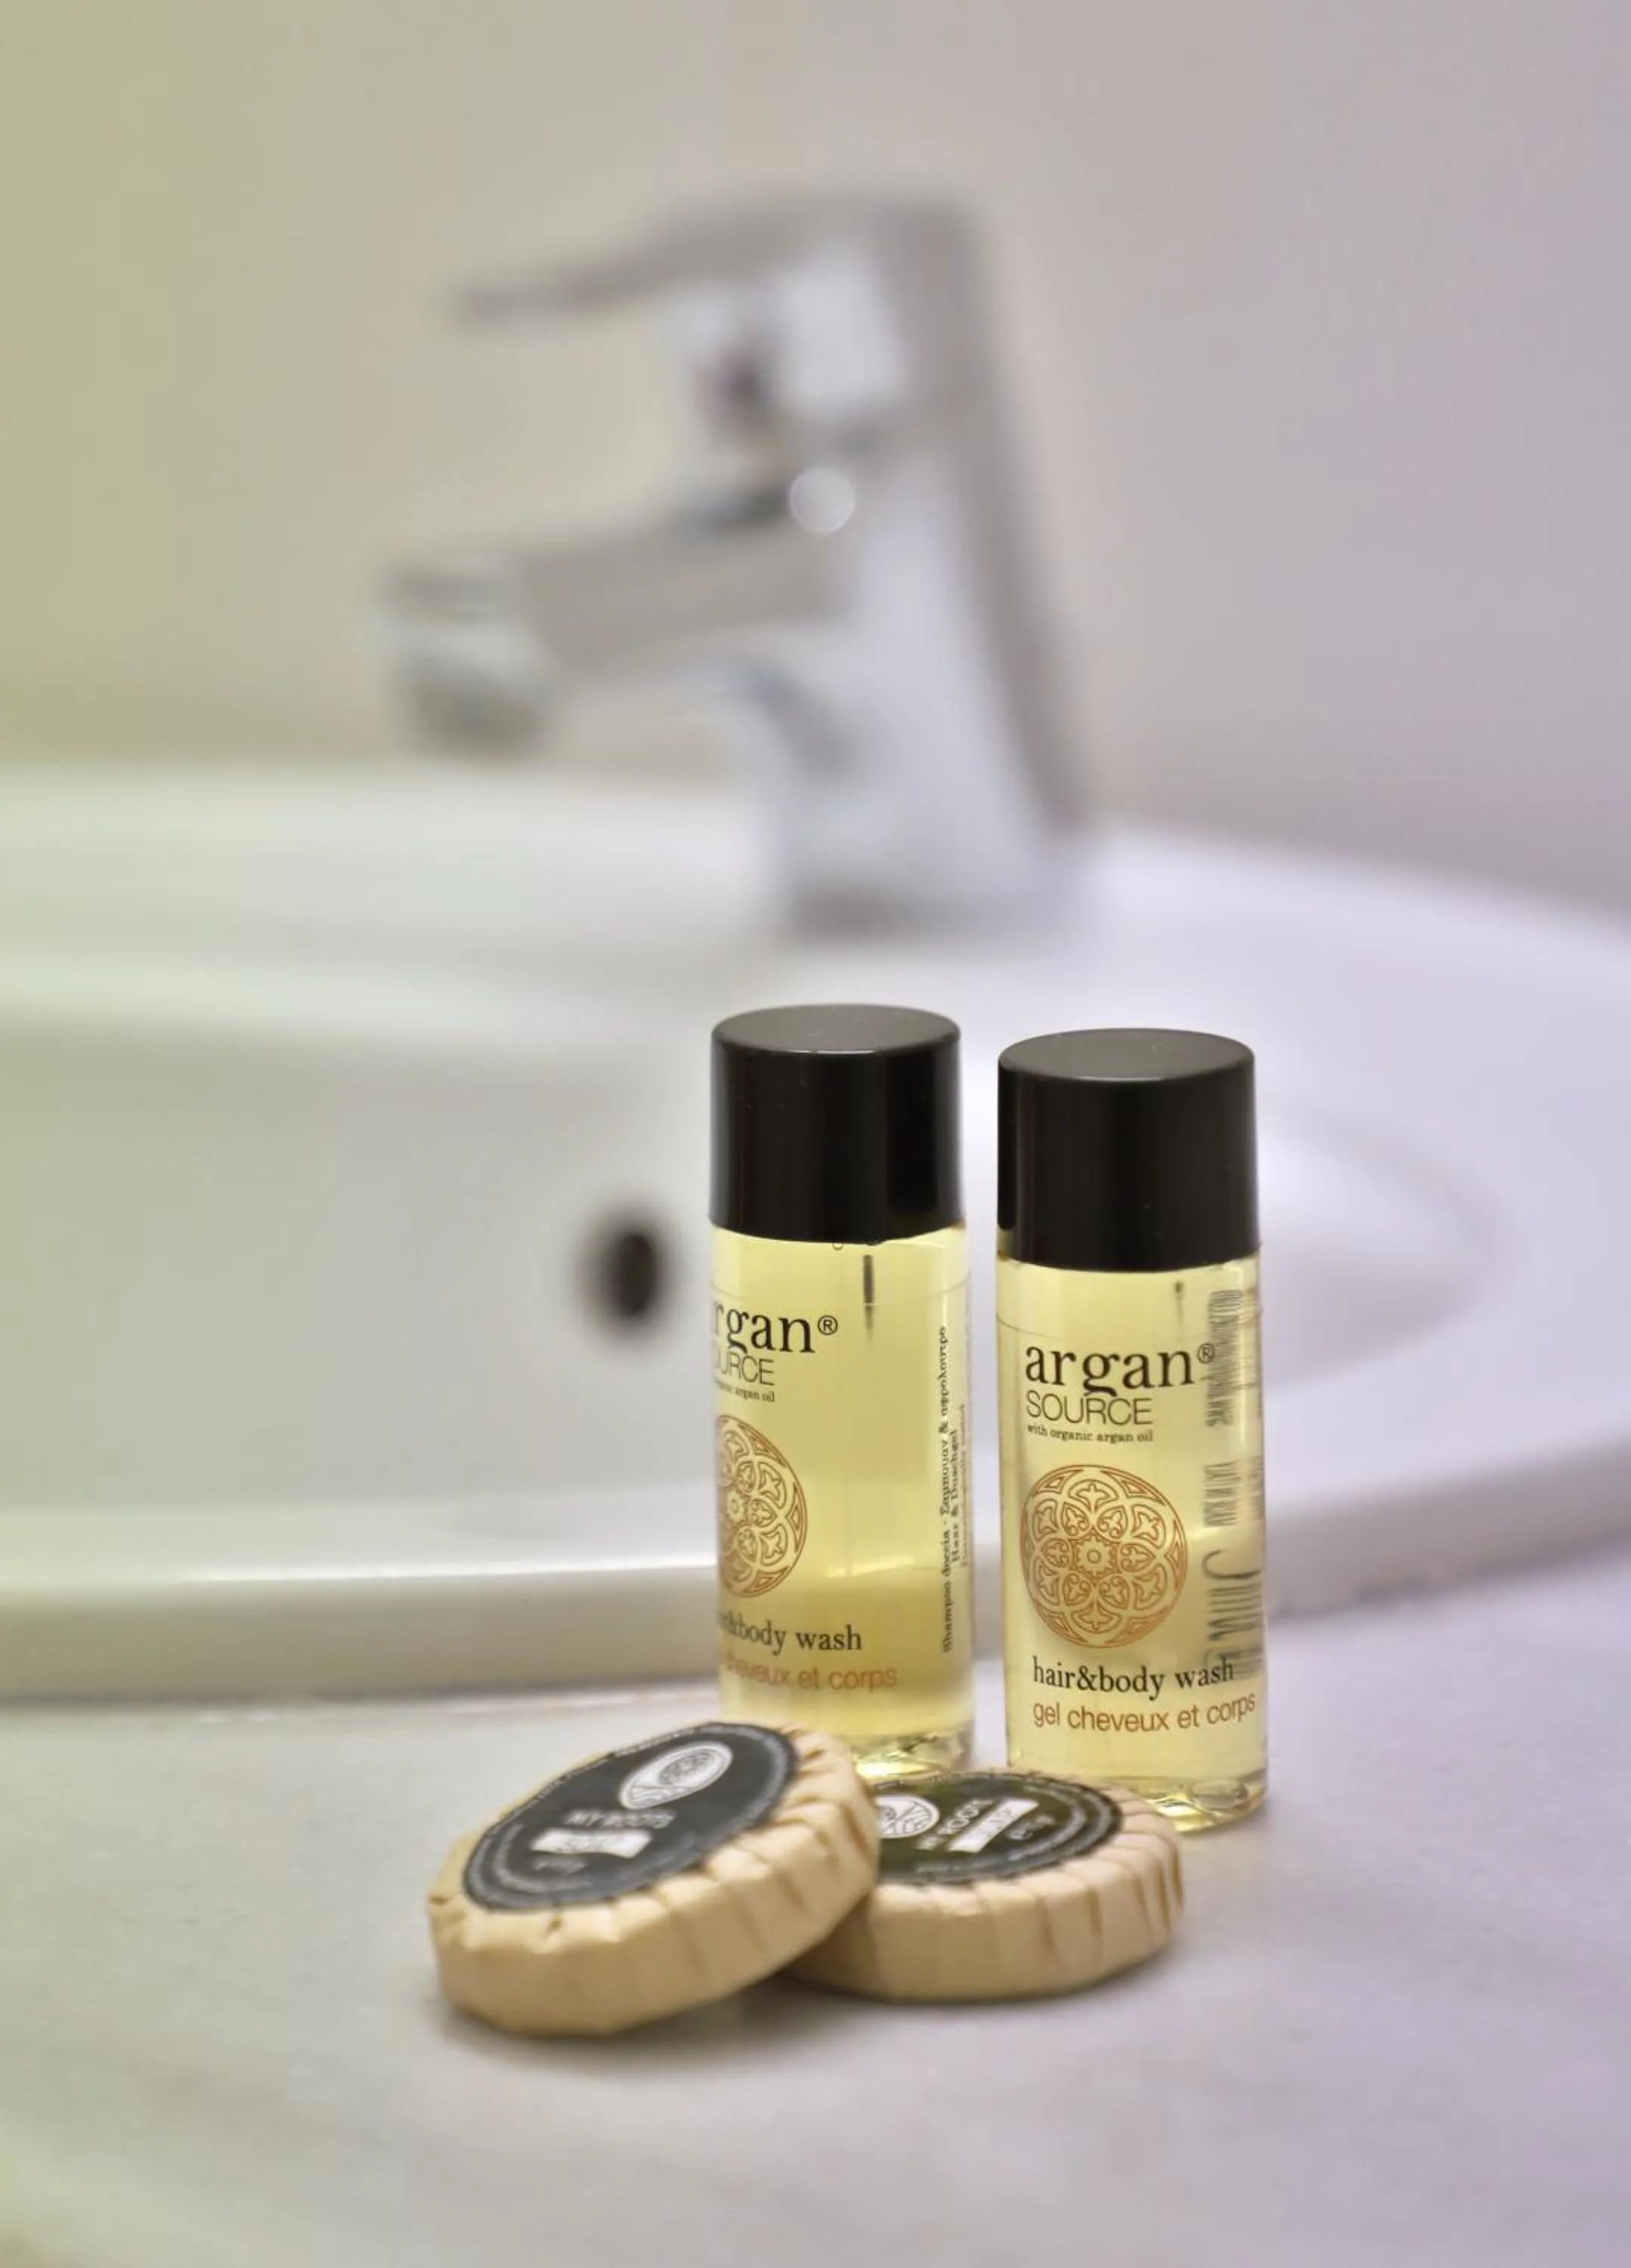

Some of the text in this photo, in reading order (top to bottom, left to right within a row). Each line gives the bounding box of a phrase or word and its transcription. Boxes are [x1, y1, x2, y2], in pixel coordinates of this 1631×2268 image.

[1026, 1390, 1153, 1426] SOURCE
[1027, 1423, 1153, 1444] with organic argan oil
[796, 1624, 863, 1651] wash
[797, 1666, 821, 1690] et
[828, 1667, 899, 1693] corps
[1032, 1655, 1234, 1701] hair&body wash
[1032, 1692, 1255, 1733] gel cheveux et corps
